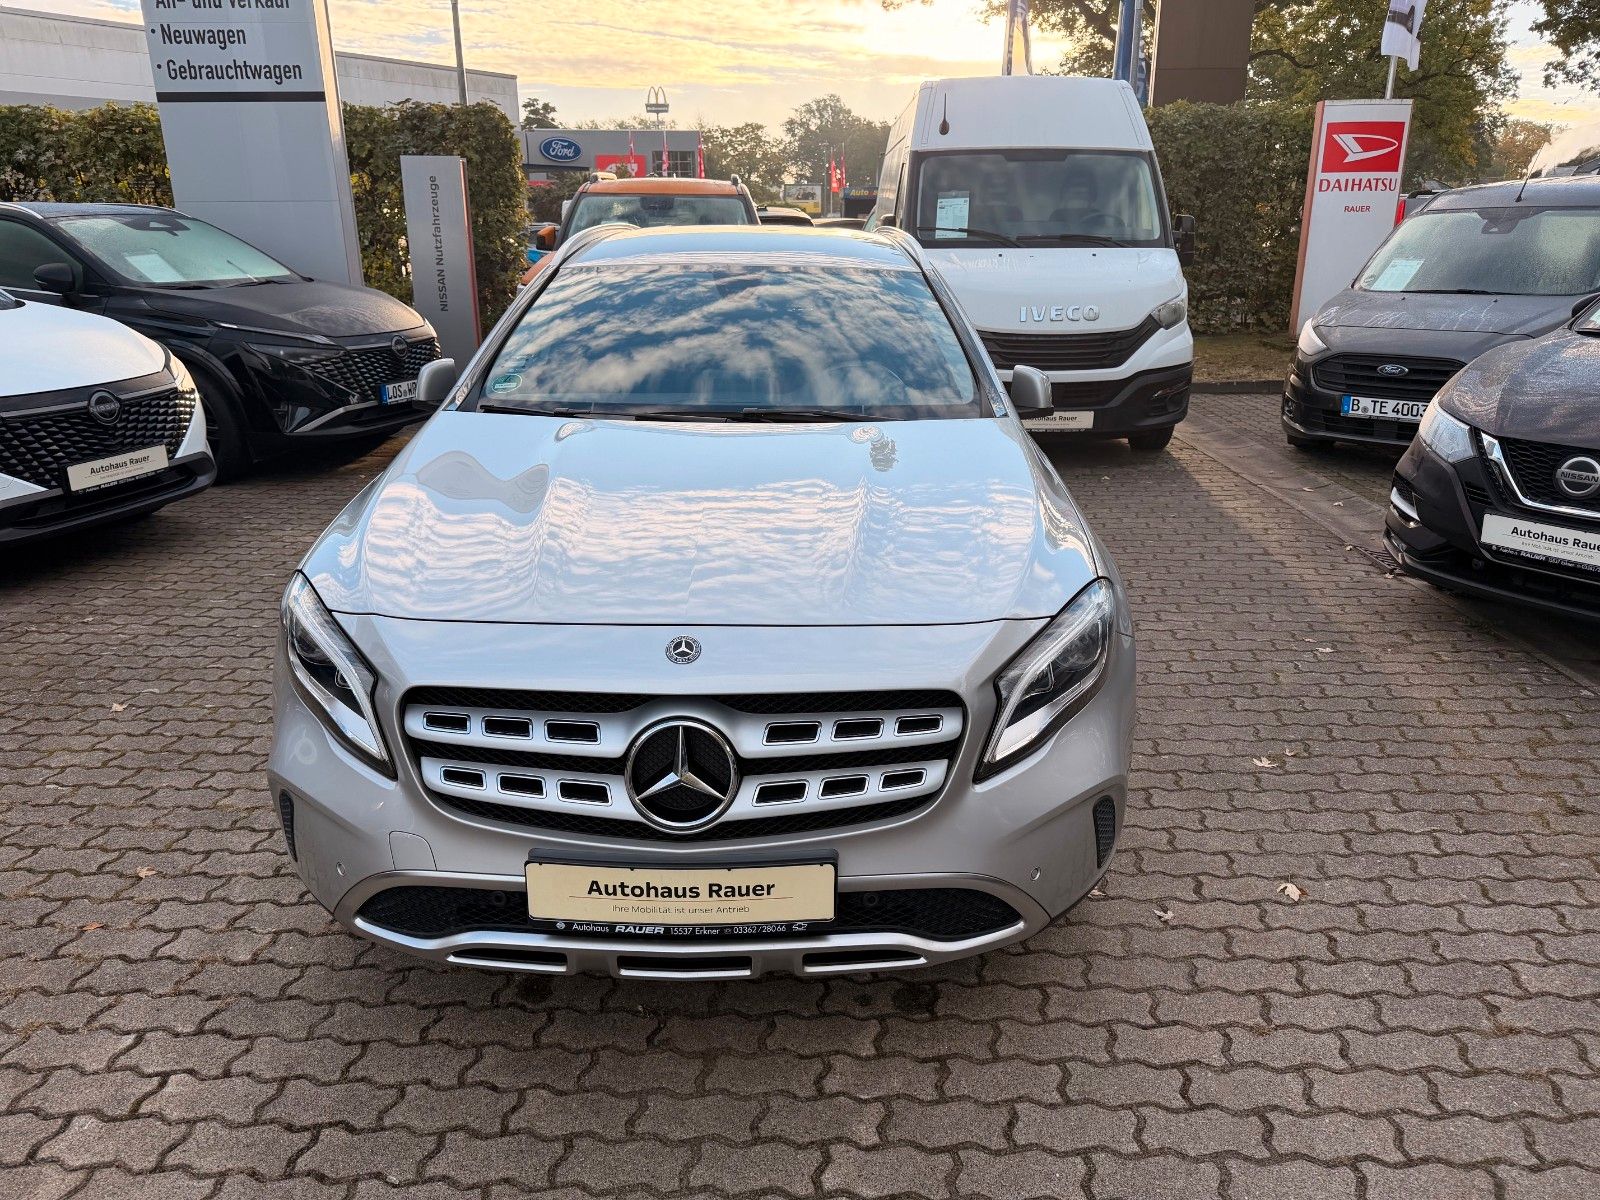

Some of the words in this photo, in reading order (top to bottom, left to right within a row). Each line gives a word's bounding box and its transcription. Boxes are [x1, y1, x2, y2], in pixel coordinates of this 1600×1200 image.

[160, 24, 247, 50] Neuwagen
[167, 59, 303, 85] Gebrauchtwagen
[550, 140, 576, 157] Ford
[1318, 178, 1398, 192] DAIHATSU
[430, 175, 444, 266] Nutzfahrzeuge
[437, 269, 448, 312] NISSAN
[1019, 304, 1100, 322] IVECO
[387, 384, 402, 400] LOS
[1351, 398, 1360, 412] B
[1371, 400, 1389, 414] TE
[90, 461, 128, 475] Autohaus
[129, 456, 150, 466] Rauer
[1560, 472, 1600, 483] NISSAN
[1511, 527, 1569, 546] Autohaus
[588, 880, 700, 898] Autohaus
[708, 882, 776, 898] Rauer
[612, 904, 630, 912] Ihre
[716, 905, 750, 914] Antrieb
[572, 922, 610, 932] Autohaus
[614, 926, 664, 934] RAUER
[670, 926, 692, 935] 15537
[695, 926, 720, 935] Erkner
